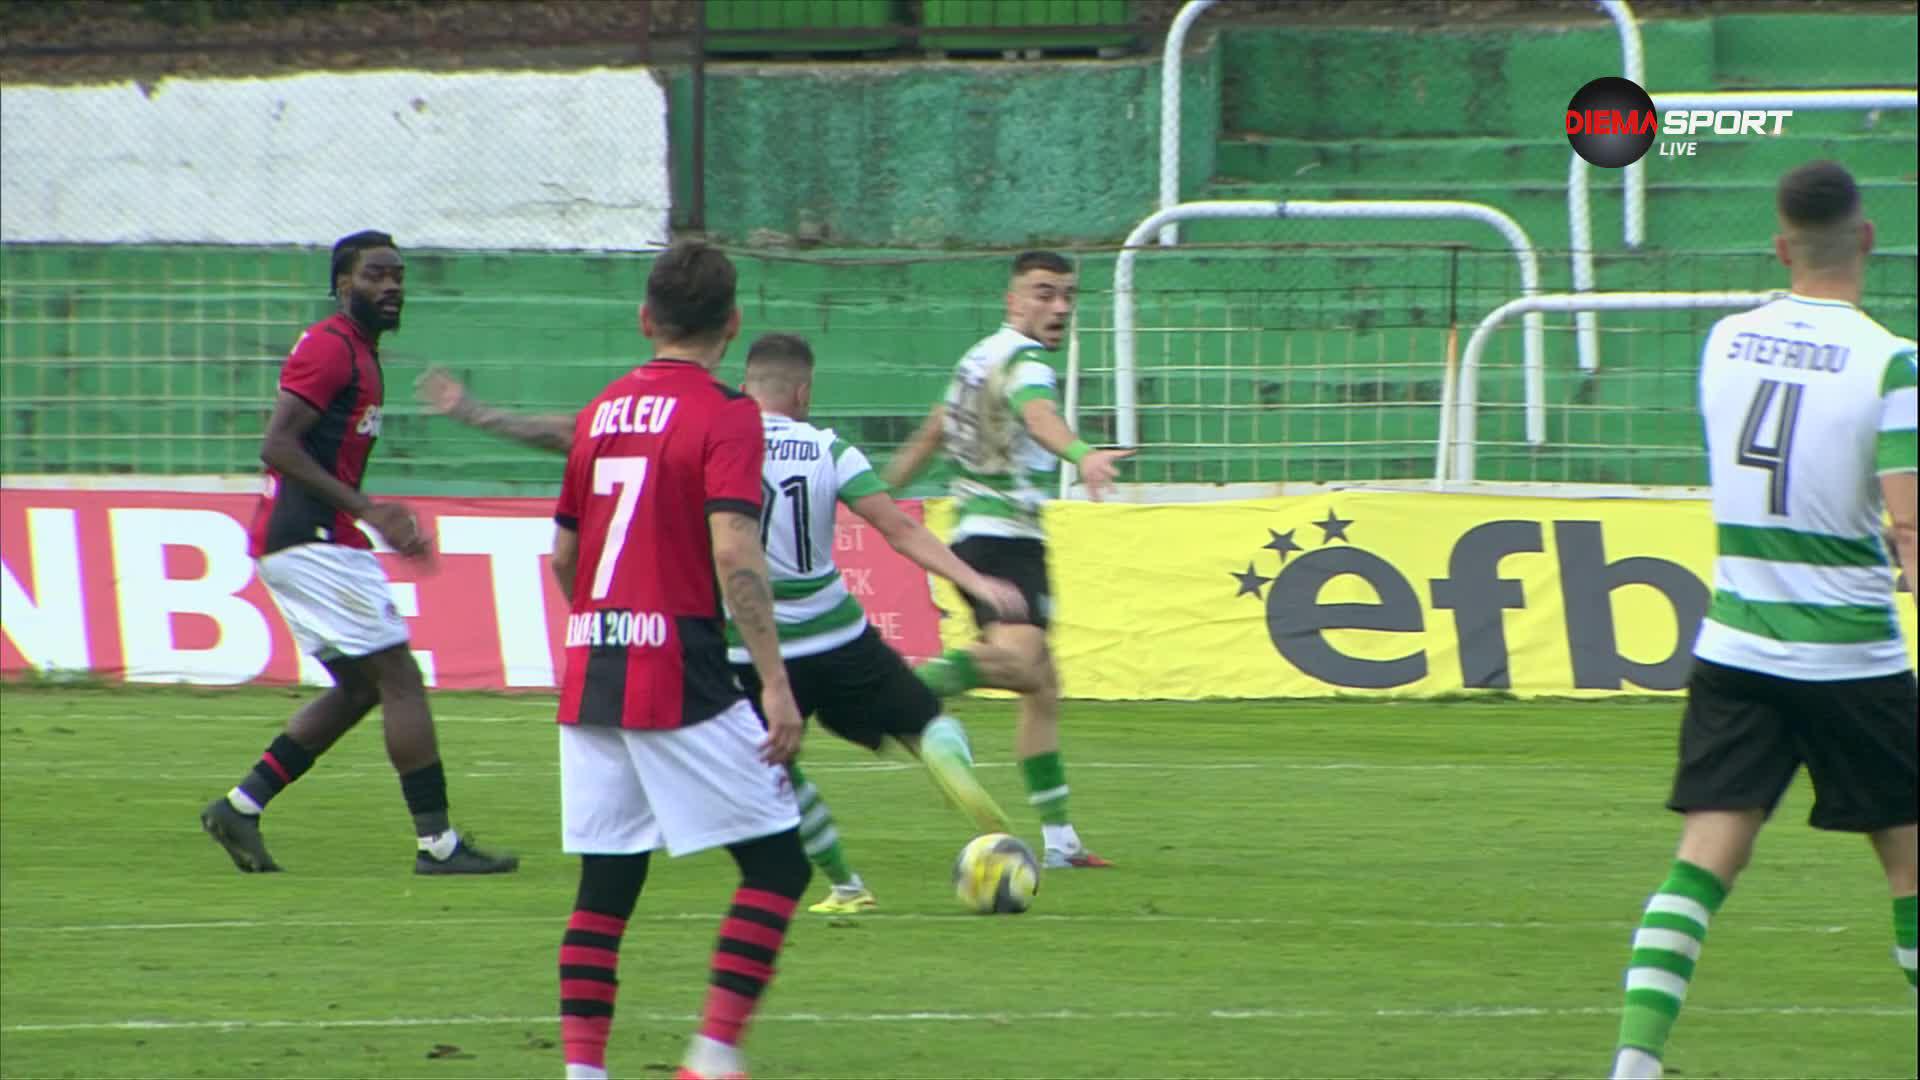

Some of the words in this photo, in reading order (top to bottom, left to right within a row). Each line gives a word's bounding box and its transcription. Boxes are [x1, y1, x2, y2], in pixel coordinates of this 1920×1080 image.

[1735, 379, 1806, 517] 4
[591, 457, 649, 600] 7
[605, 611, 667, 647] 2000
[1265, 519, 1712, 691] efb
